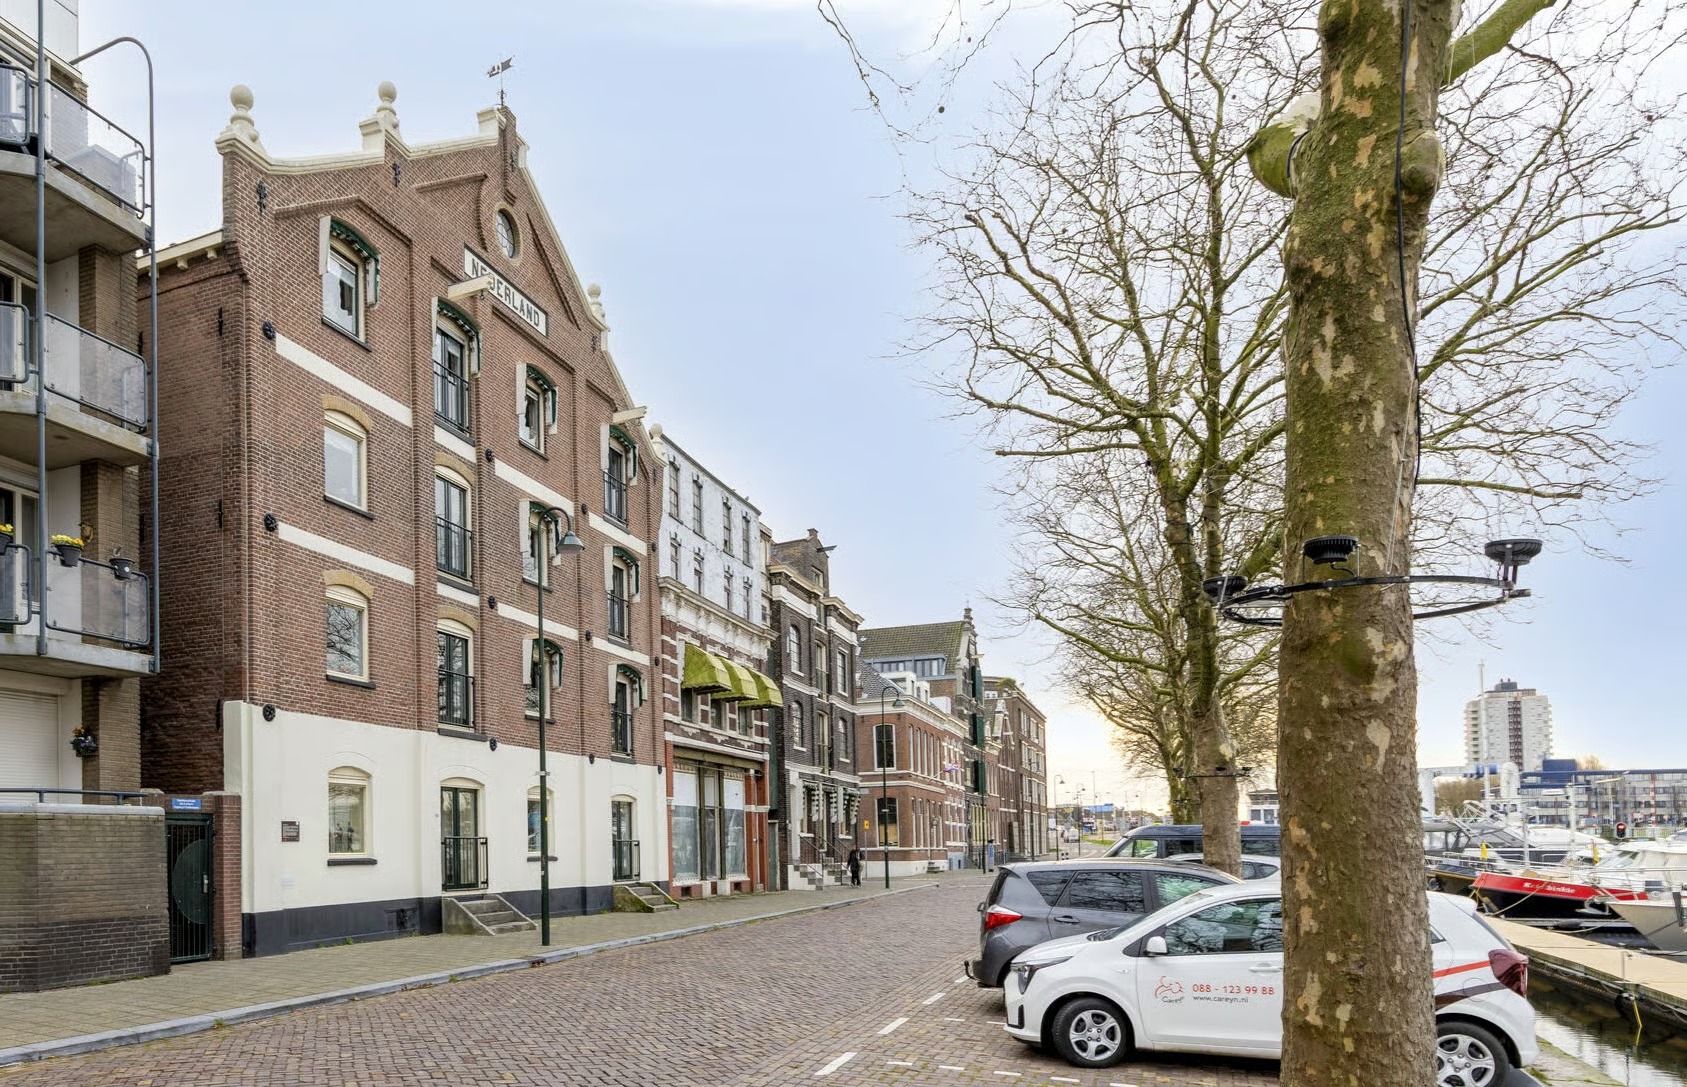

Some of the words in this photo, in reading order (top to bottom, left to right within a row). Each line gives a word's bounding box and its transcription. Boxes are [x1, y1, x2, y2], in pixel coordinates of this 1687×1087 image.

[1192, 984, 1212, 993] 088
[1223, 985, 1241, 994] 123
[1244, 986, 1258, 995] 99
[1261, 986, 1275, 996] 88
[1193, 996, 1249, 1004] www.careyn.nl
